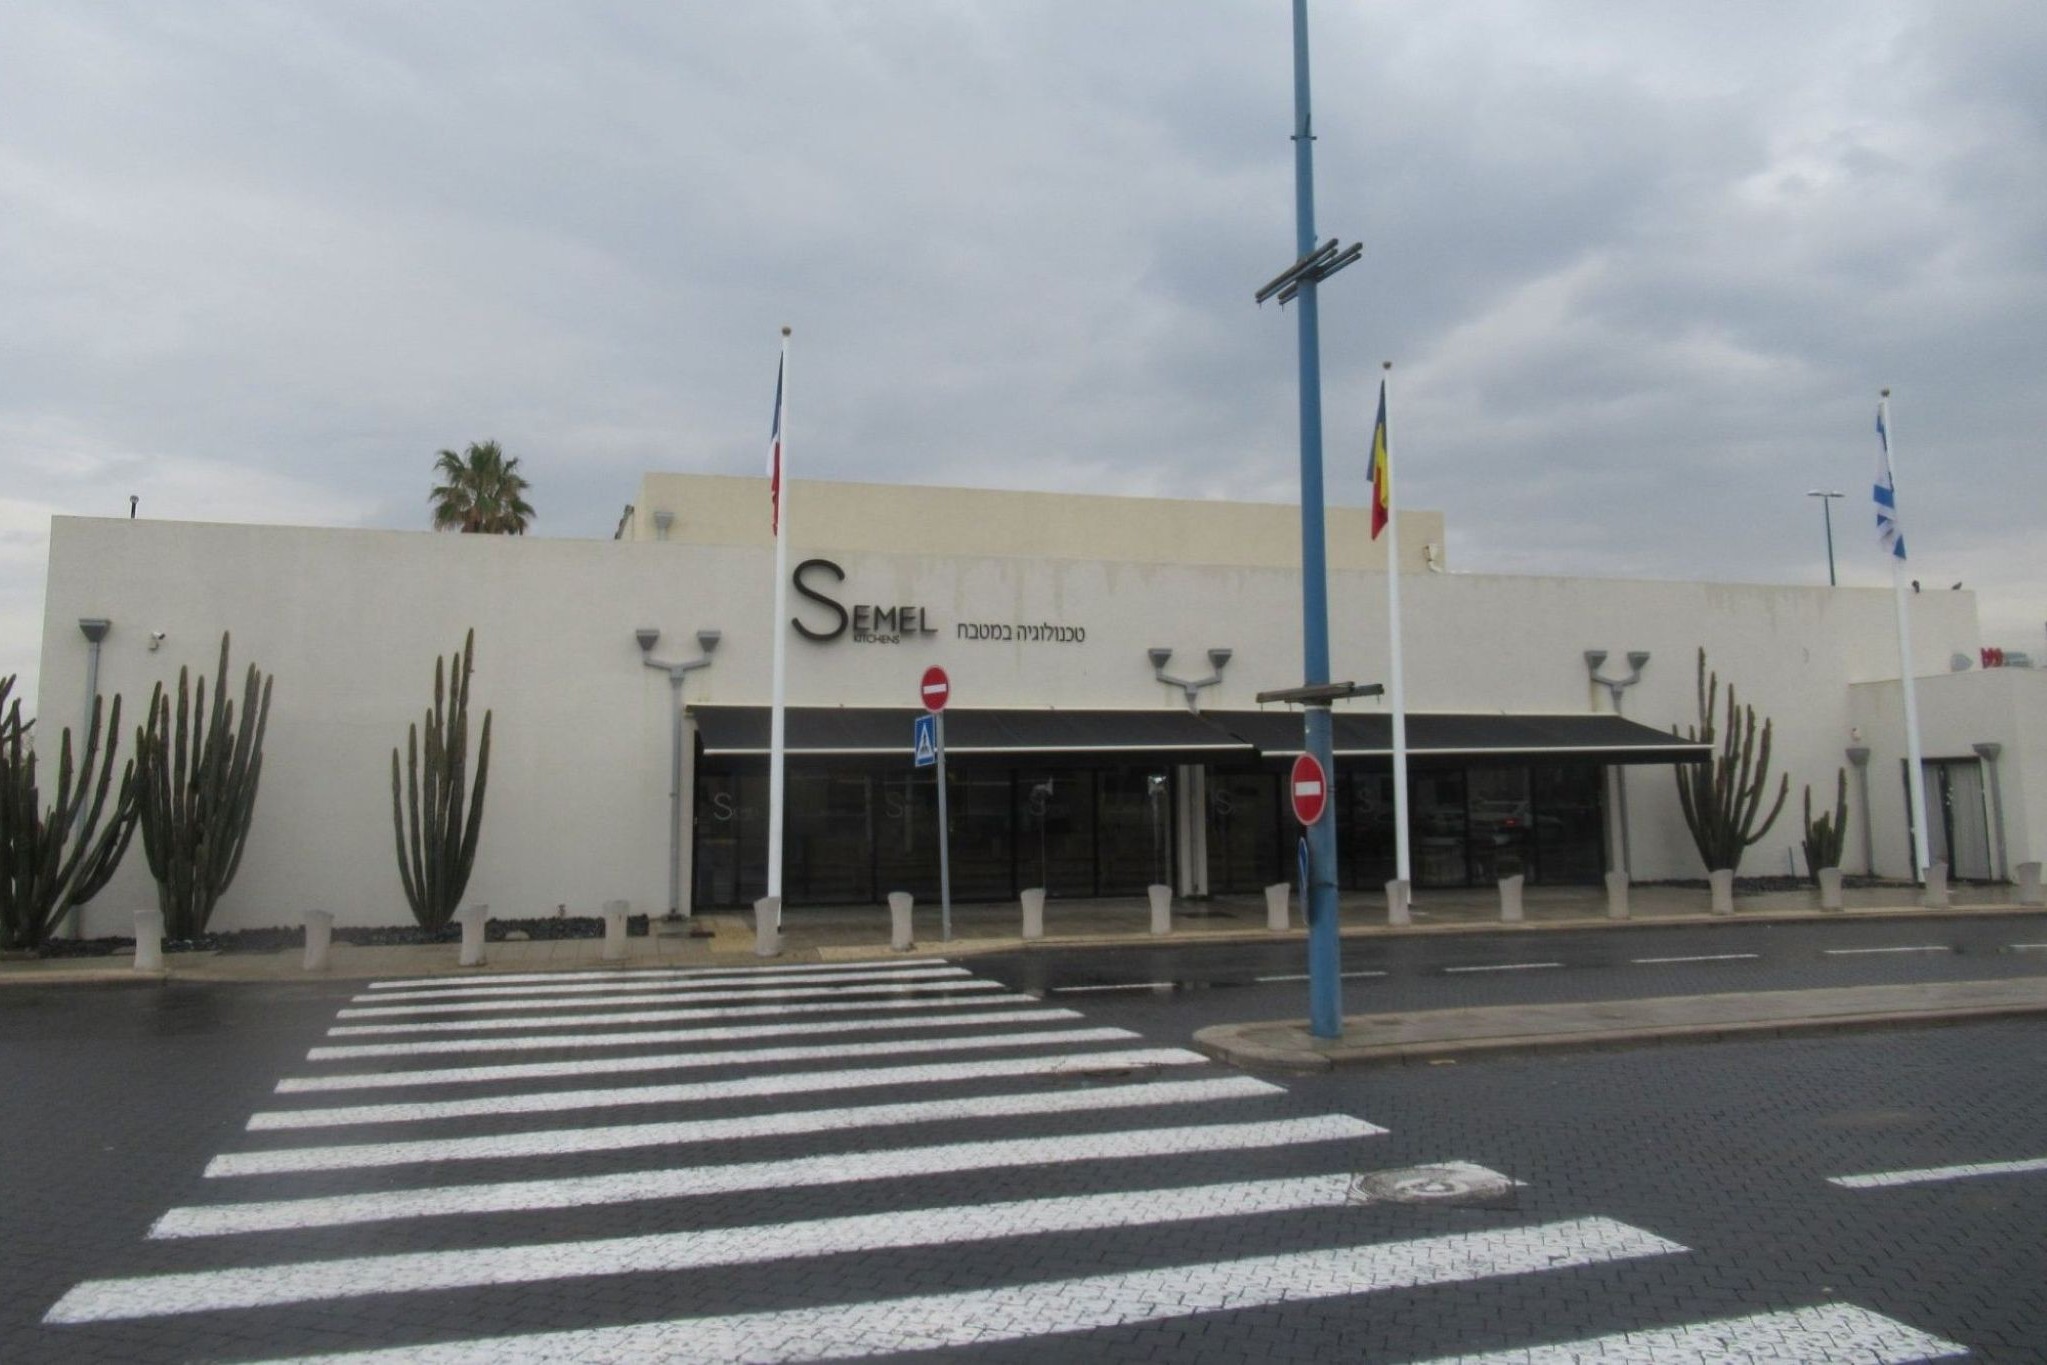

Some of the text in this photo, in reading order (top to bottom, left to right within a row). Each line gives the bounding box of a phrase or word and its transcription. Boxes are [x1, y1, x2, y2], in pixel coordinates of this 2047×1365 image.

[854, 633, 900, 644] KITCHENS
[957, 621, 1085, 642] טכנולוגיה במטבח
